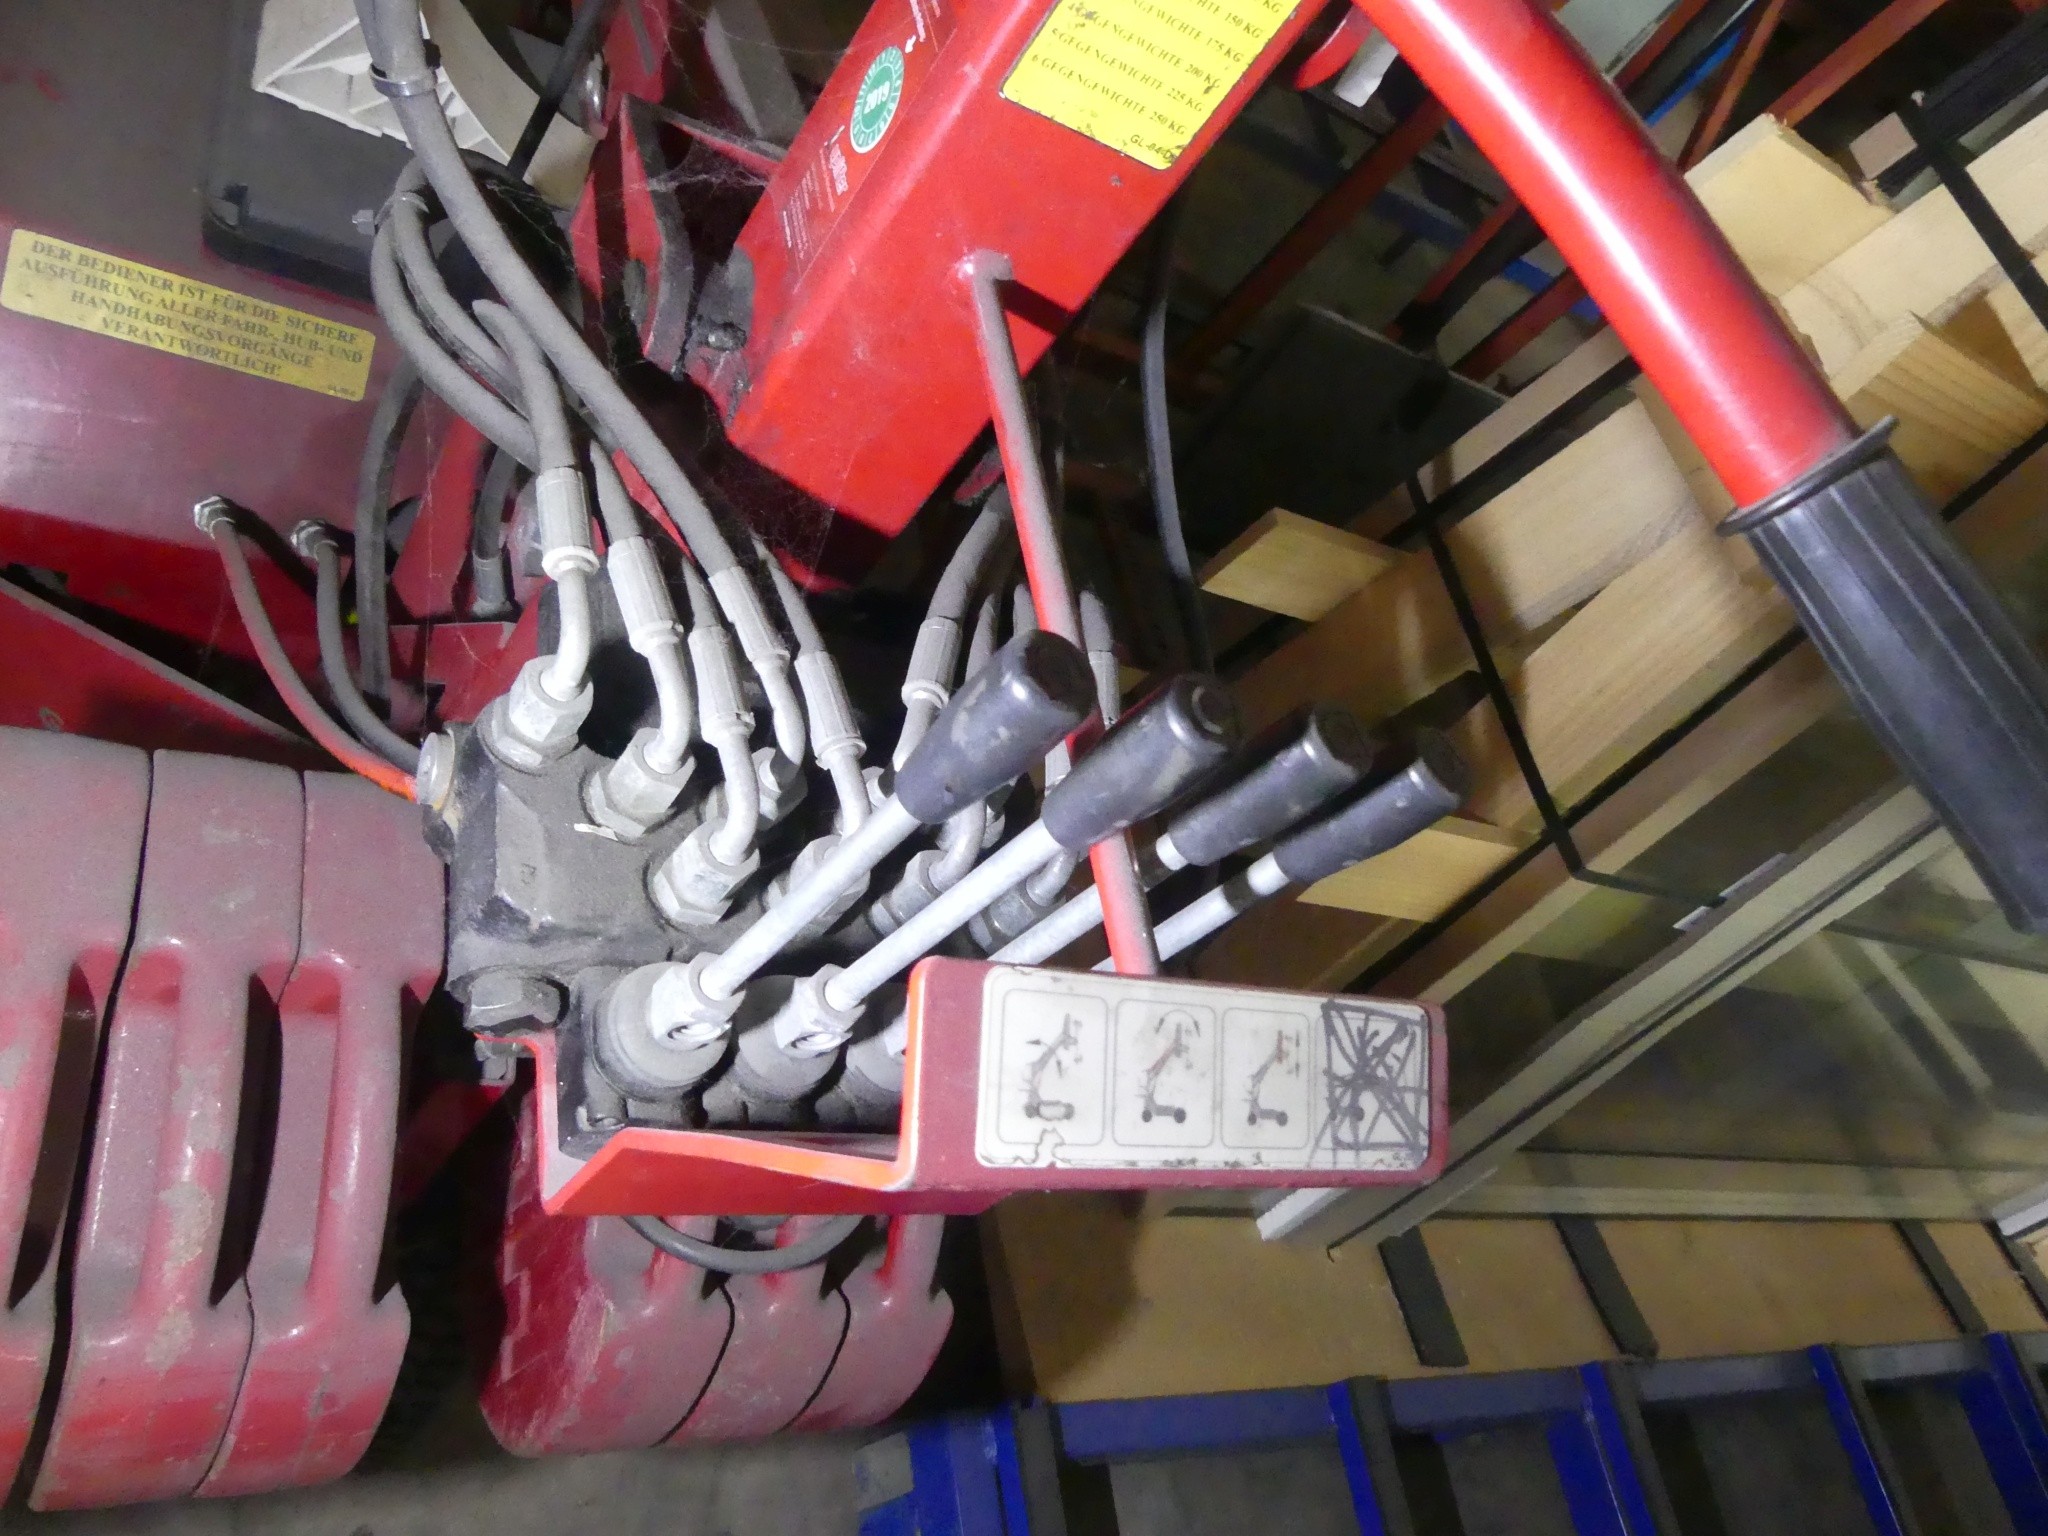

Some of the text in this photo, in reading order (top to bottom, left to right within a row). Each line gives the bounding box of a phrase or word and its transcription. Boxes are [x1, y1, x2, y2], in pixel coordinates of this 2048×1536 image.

[1206, 37, 1225, 53] 175
[1224, 47, 1245, 62] KG
[1224, 12, 1264, 39] 150 KG
[863, 80, 891, 115] 2019
[1041, 57, 1147, 114] GEGENGEWICHTE
[1149, 111, 1169, 126] 250
[1168, 120, 1187, 136] KG
[1059, 32, 1164, 90] GEGENGEWICHTE
[1167, 87, 1187, 102] 225
[1186, 97, 1203, 113] KG
[1185, 63, 1204, 78] 200
[1204, 73, 1222, 89] KG
[19, 258, 152, 305] AUSFÜHRUNG
[156, 297, 217, 323] ALLER
[283, 331, 323, 352] HUB-
[329, 344, 363, 363] UND
[32, 240, 358, 344] DER BEDIENER IST FÜR DIE SICHERE
[71, 289, 314, 368] HANDHABUNGSVORGÄNGE
[101, 316, 282, 376] VERANTWORTLICH!
